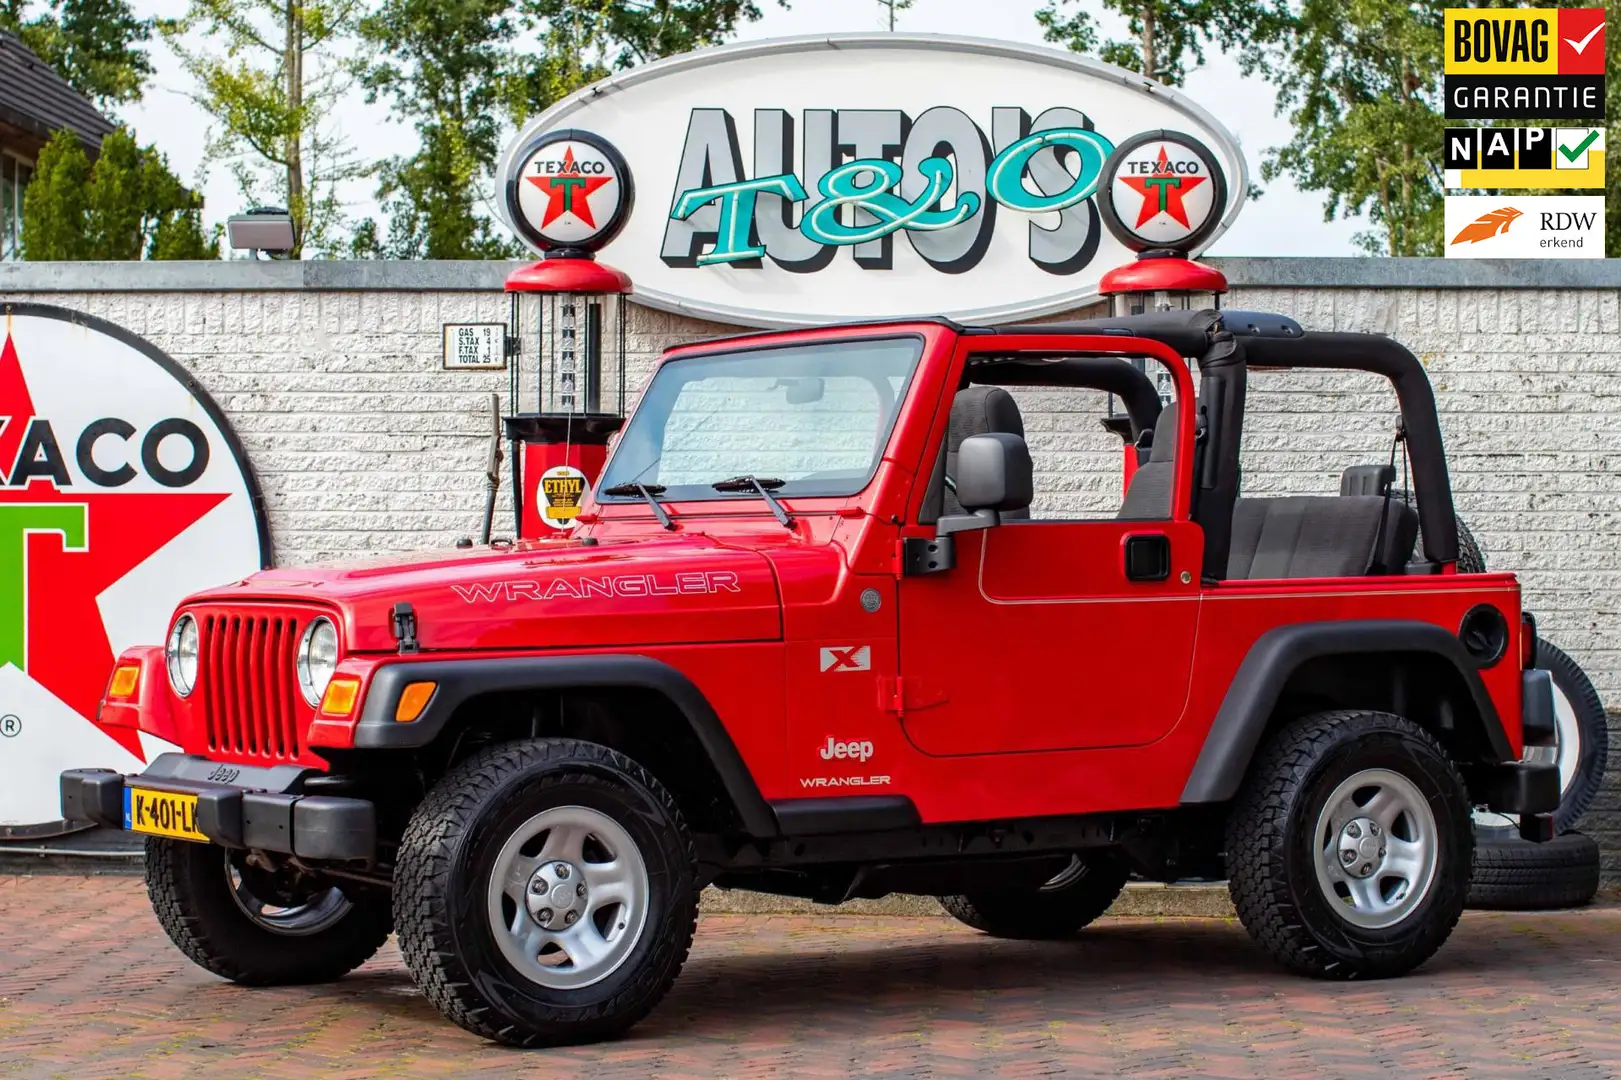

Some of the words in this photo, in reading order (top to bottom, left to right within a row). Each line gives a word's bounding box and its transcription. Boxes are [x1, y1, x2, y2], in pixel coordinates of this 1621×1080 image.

[534, 161, 605, 174] TEXACO
[1127, 161, 1199, 174] TEXACO
[549, 177, 587, 213] T
[660, 106, 1102, 275] AUTO'S
[1144, 177, 1181, 213] T
[458, 327, 474, 337] GAS
[483, 327, 491, 337] 19
[458, 336, 480, 346] S.TAX
[486, 337, 491, 345] 4
[458, 345, 479, 355] F.TAX
[458, 354, 480, 364] TOTAL
[482, 354, 491, 364] 25
[0, 417, 210, 488] ACO
[544, 479, 582, 494] ETHYL
[450, 571, 741, 603] WRANGLER
[821, 646, 870, 672] X
[820, 737, 873, 762] Jeep
[800, 775, 891, 788] WRANGLER
